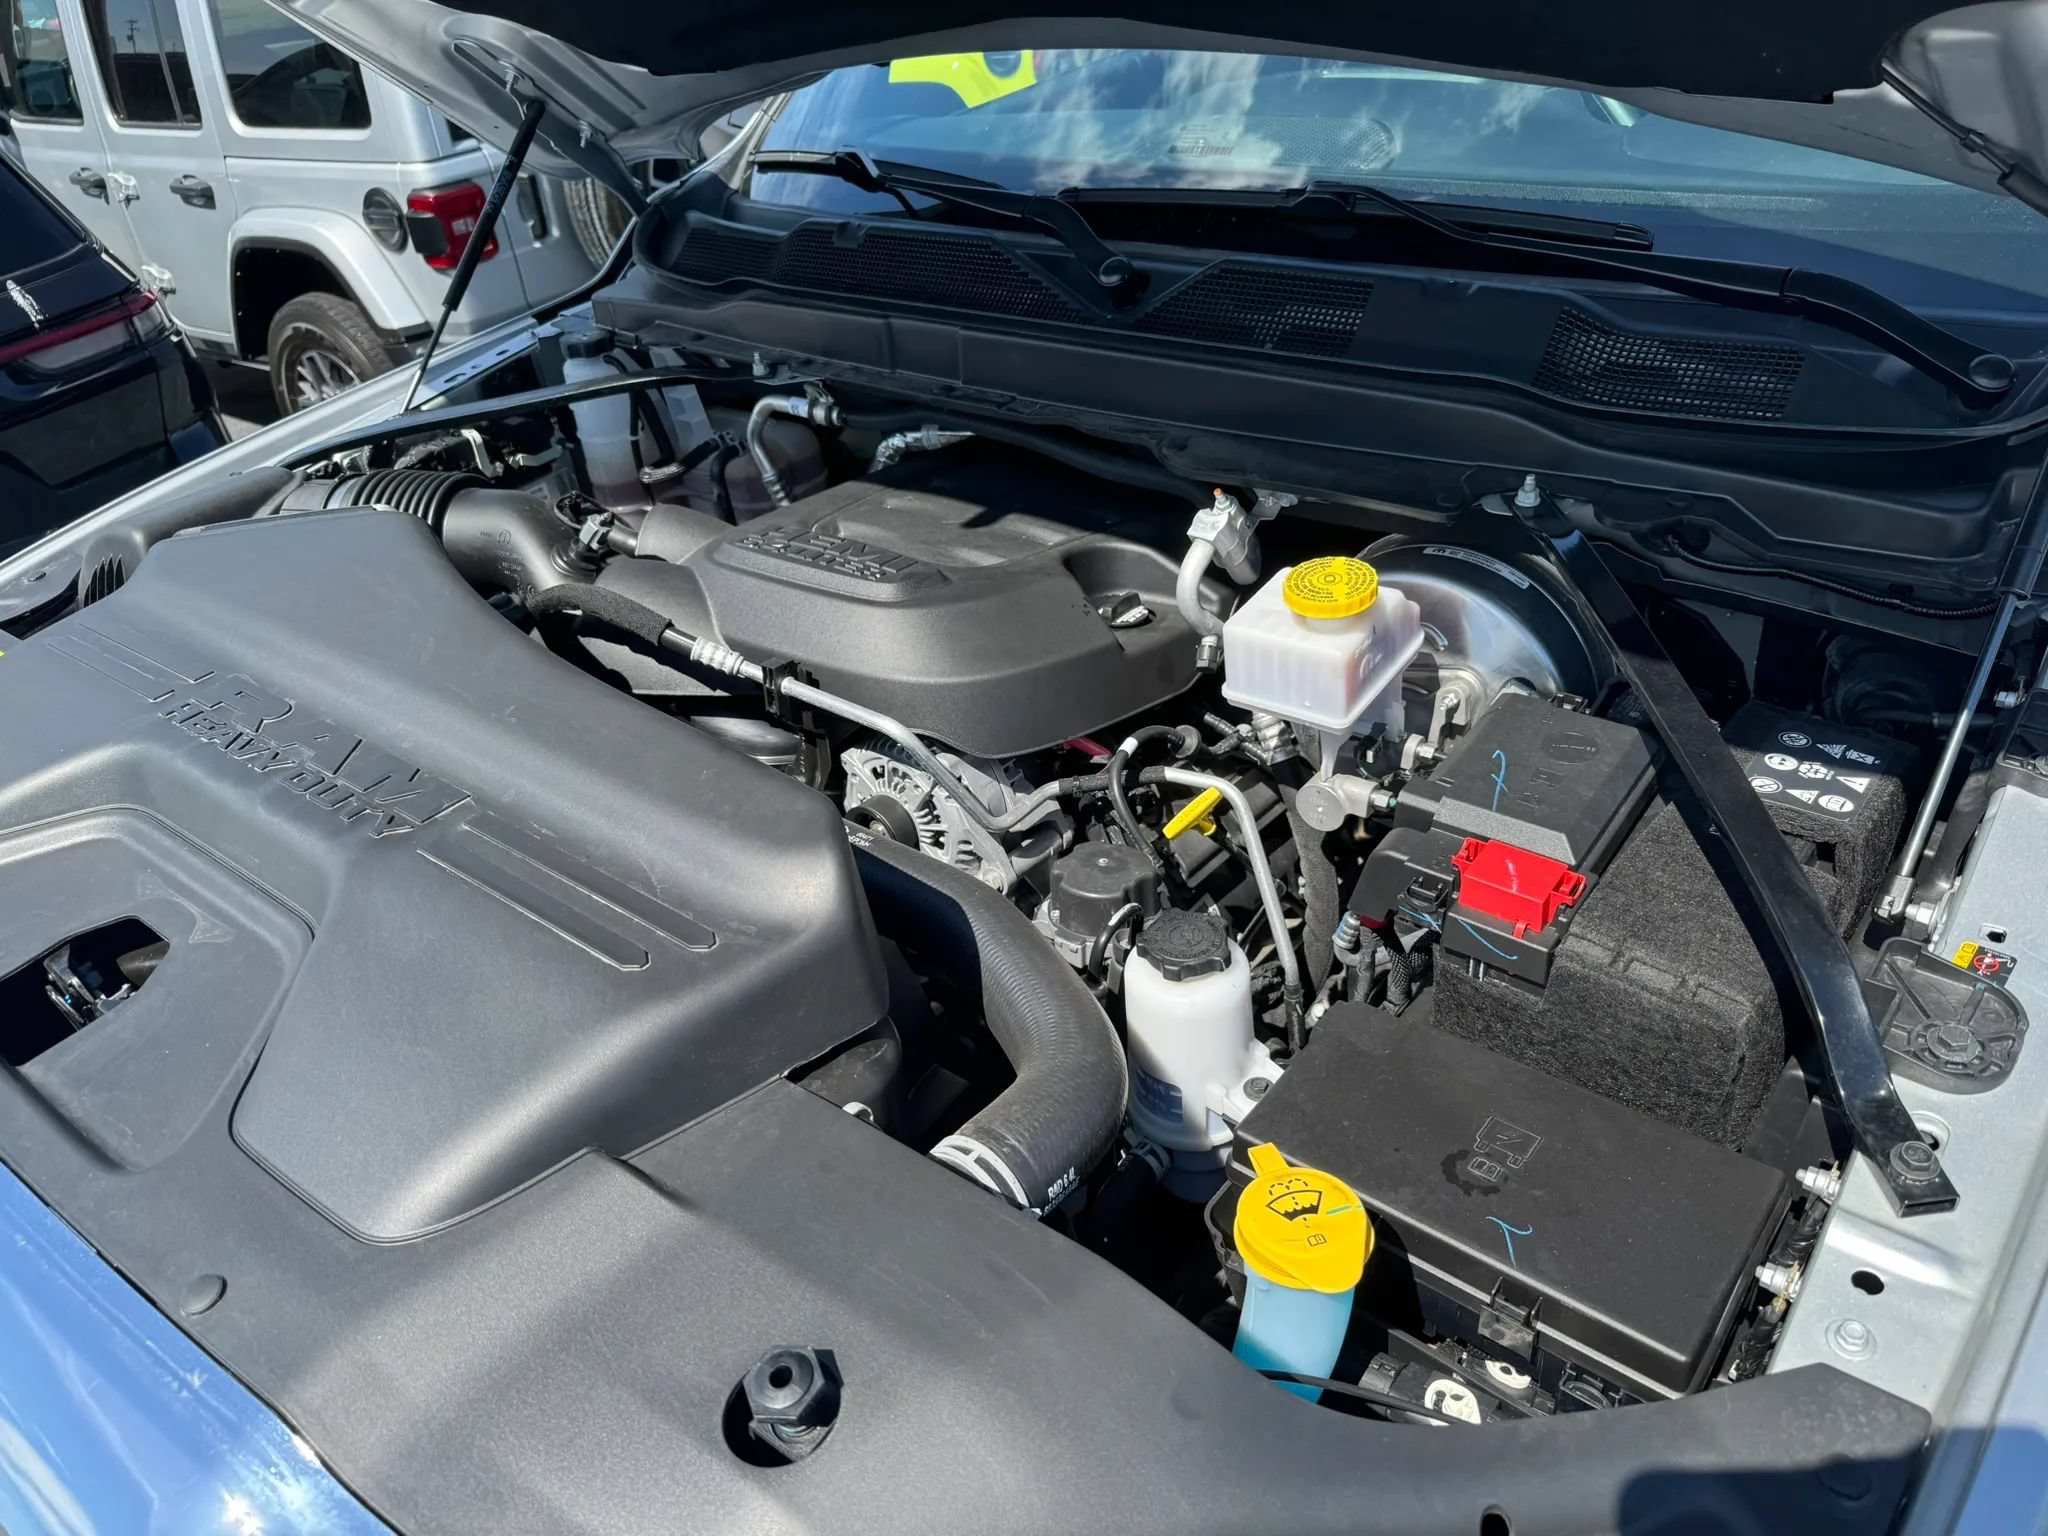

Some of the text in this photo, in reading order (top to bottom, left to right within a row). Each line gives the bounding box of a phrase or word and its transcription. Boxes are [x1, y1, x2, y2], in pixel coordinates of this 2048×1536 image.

[749, 525, 920, 574] HEMI
[157, 702, 415, 839] HEAVY DUTY
[190, 673, 472, 825] RAM
